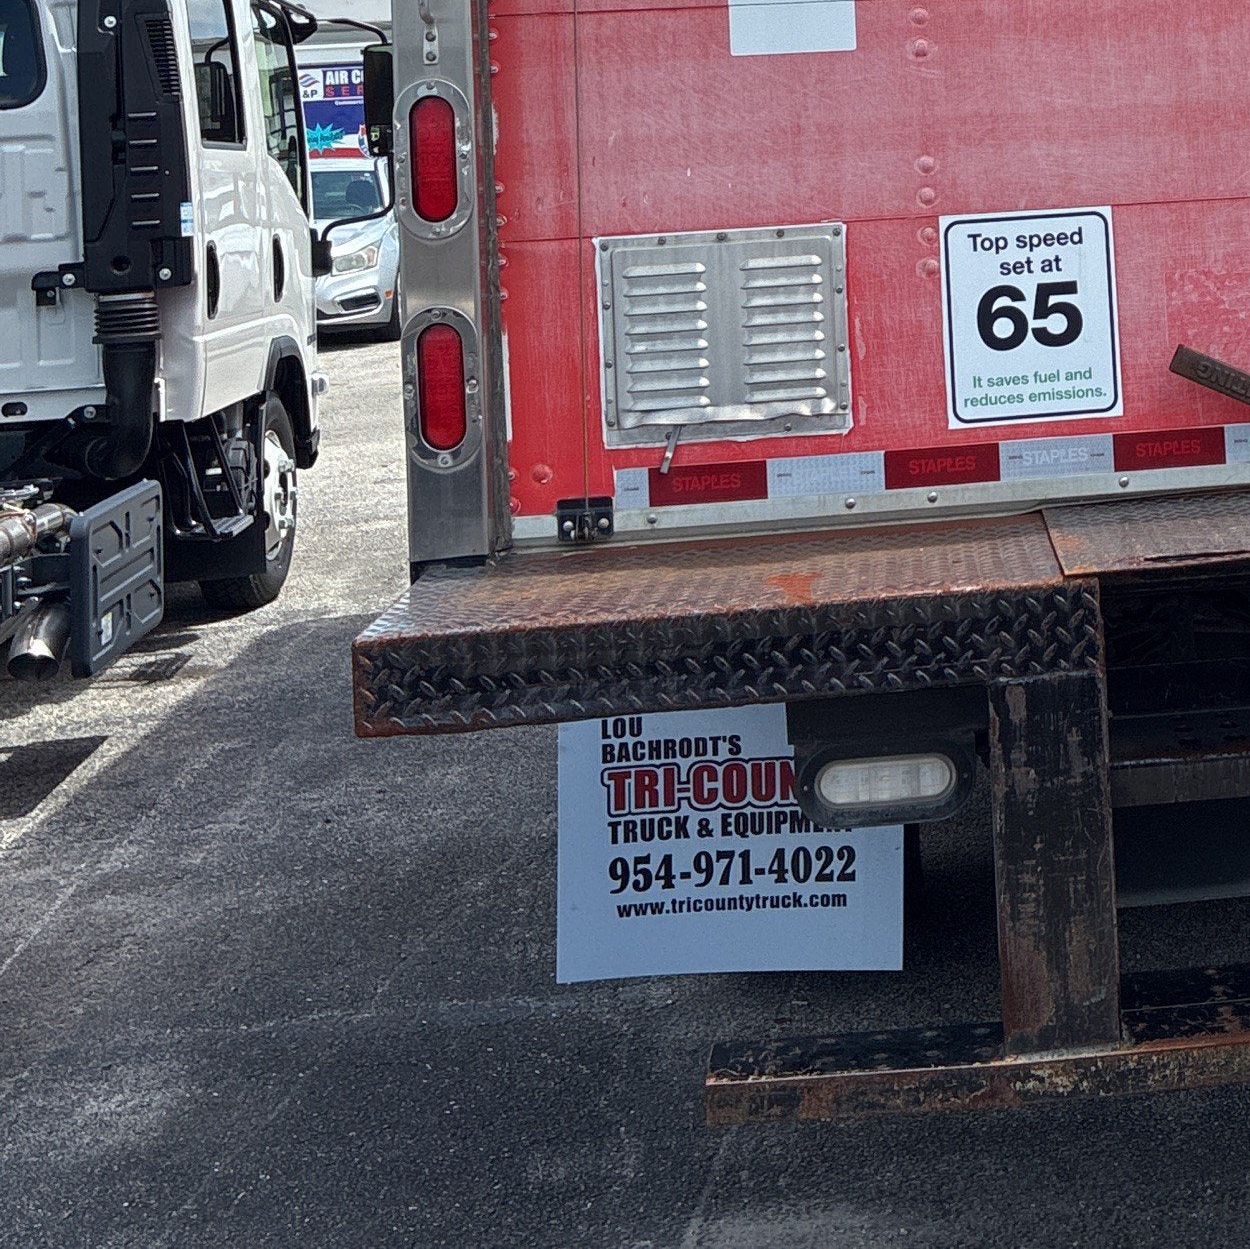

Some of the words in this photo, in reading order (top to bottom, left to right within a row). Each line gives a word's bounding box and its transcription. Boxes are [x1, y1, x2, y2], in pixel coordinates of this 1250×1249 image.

[325, 70, 349, 85] AIR
[967, 233, 1008, 254] Top
[1015, 226, 1083, 252] speed
[999, 257, 1034, 276] set
[1040, 255, 1062, 273] at
[976, 280, 1083, 352] 65
[972, 375, 983, 388] It
[987, 374, 1029, 387] saves
[1033, 369, 1060, 384] fuel
[1065, 367, 1093, 381] and
[964, 393, 1025, 408] reduces
[1028, 386, 1107, 403] emissions.
[673, 472, 742, 492] STAPLES
[908, 455, 976, 476] STAPLES
[1022, 447, 1089, 466] STAPLES
[1135, 439, 1201, 458] STAPLES
[601, 716, 643, 740] LOU
[601, 734, 742, 764] BACHRODT'S
[606, 760, 798, 812] TRI-COUN
[607, 815, 690, 845] TRUCK
[697, 817, 714, 838] &
[721, 810, 852, 838] EQUIPM
[608, 845, 857, 894] 954-971-4022
[616, 892, 848, 918] www.tricountytruck.com
